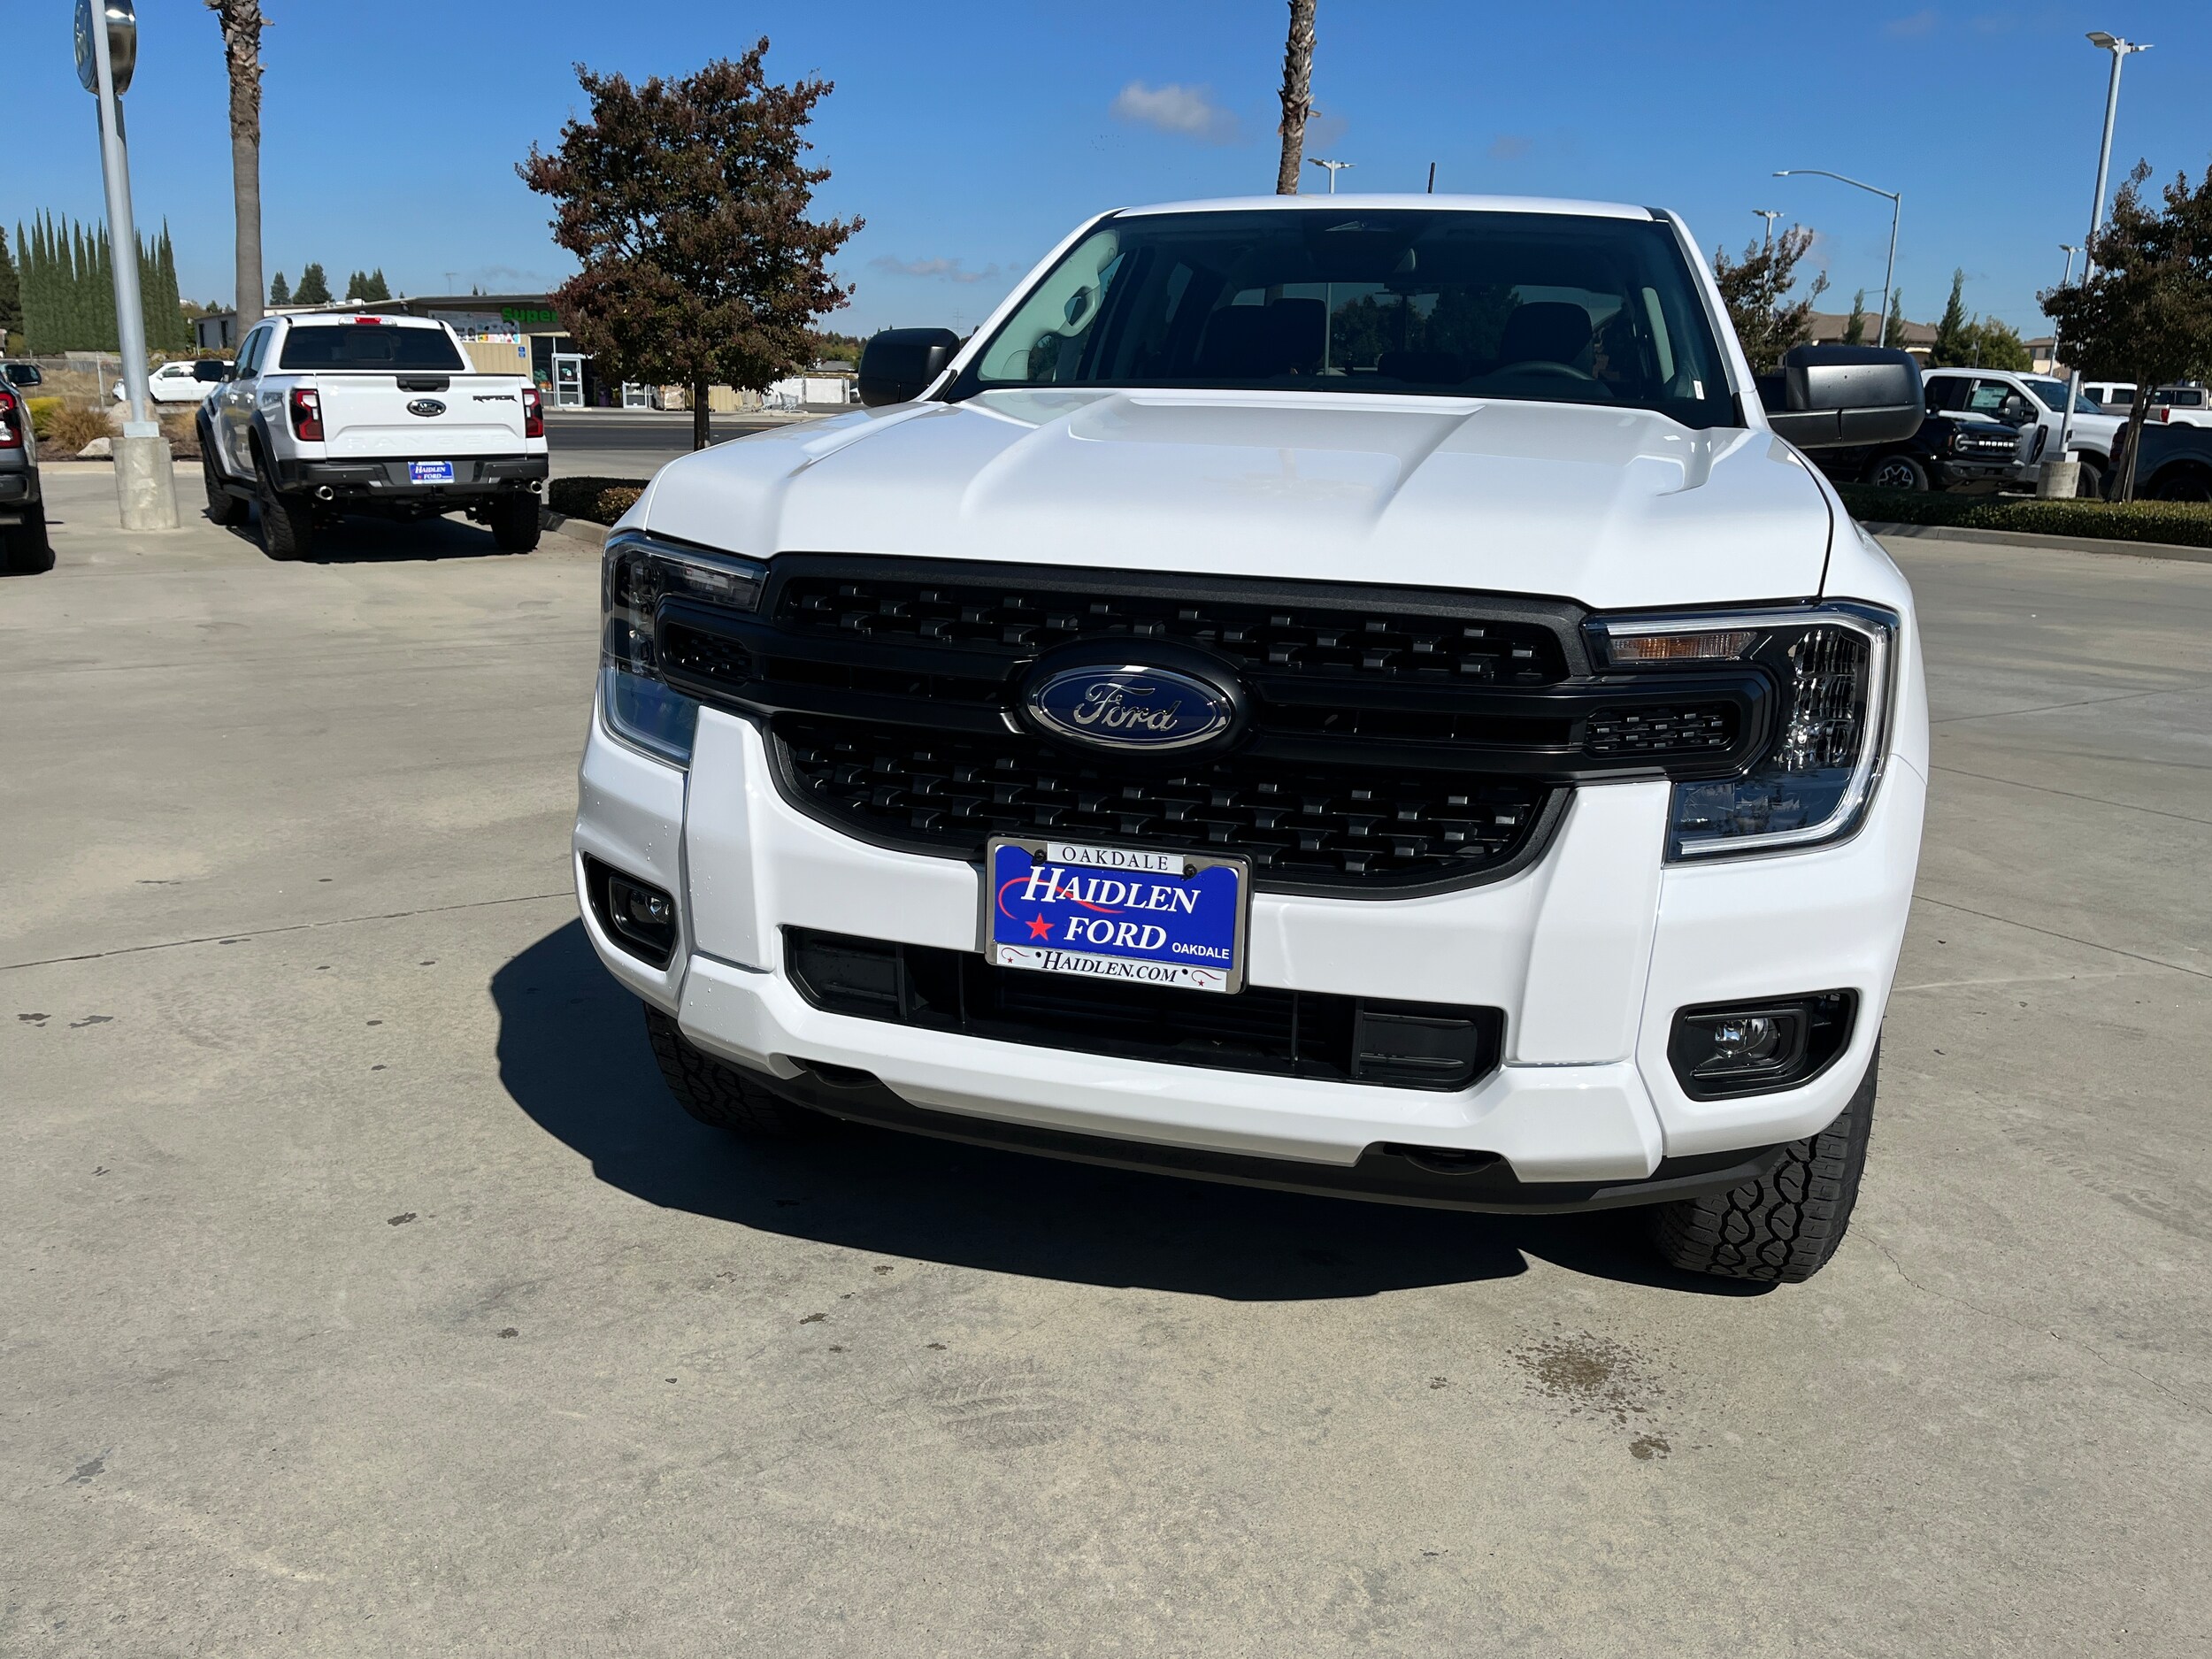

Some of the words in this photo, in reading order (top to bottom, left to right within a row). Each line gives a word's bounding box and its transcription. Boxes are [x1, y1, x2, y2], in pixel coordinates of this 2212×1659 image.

[502, 306, 558, 323] Super
[415, 465, 446, 474] HAIDLEN
[1073, 682, 1182, 732] Ford
[1062, 846, 1169, 871] OAKDALE
[1020, 864, 1202, 914] HAIDLEN
[1063, 916, 1167, 950] FORD
[1171, 941, 1231, 960] OAKDALE
